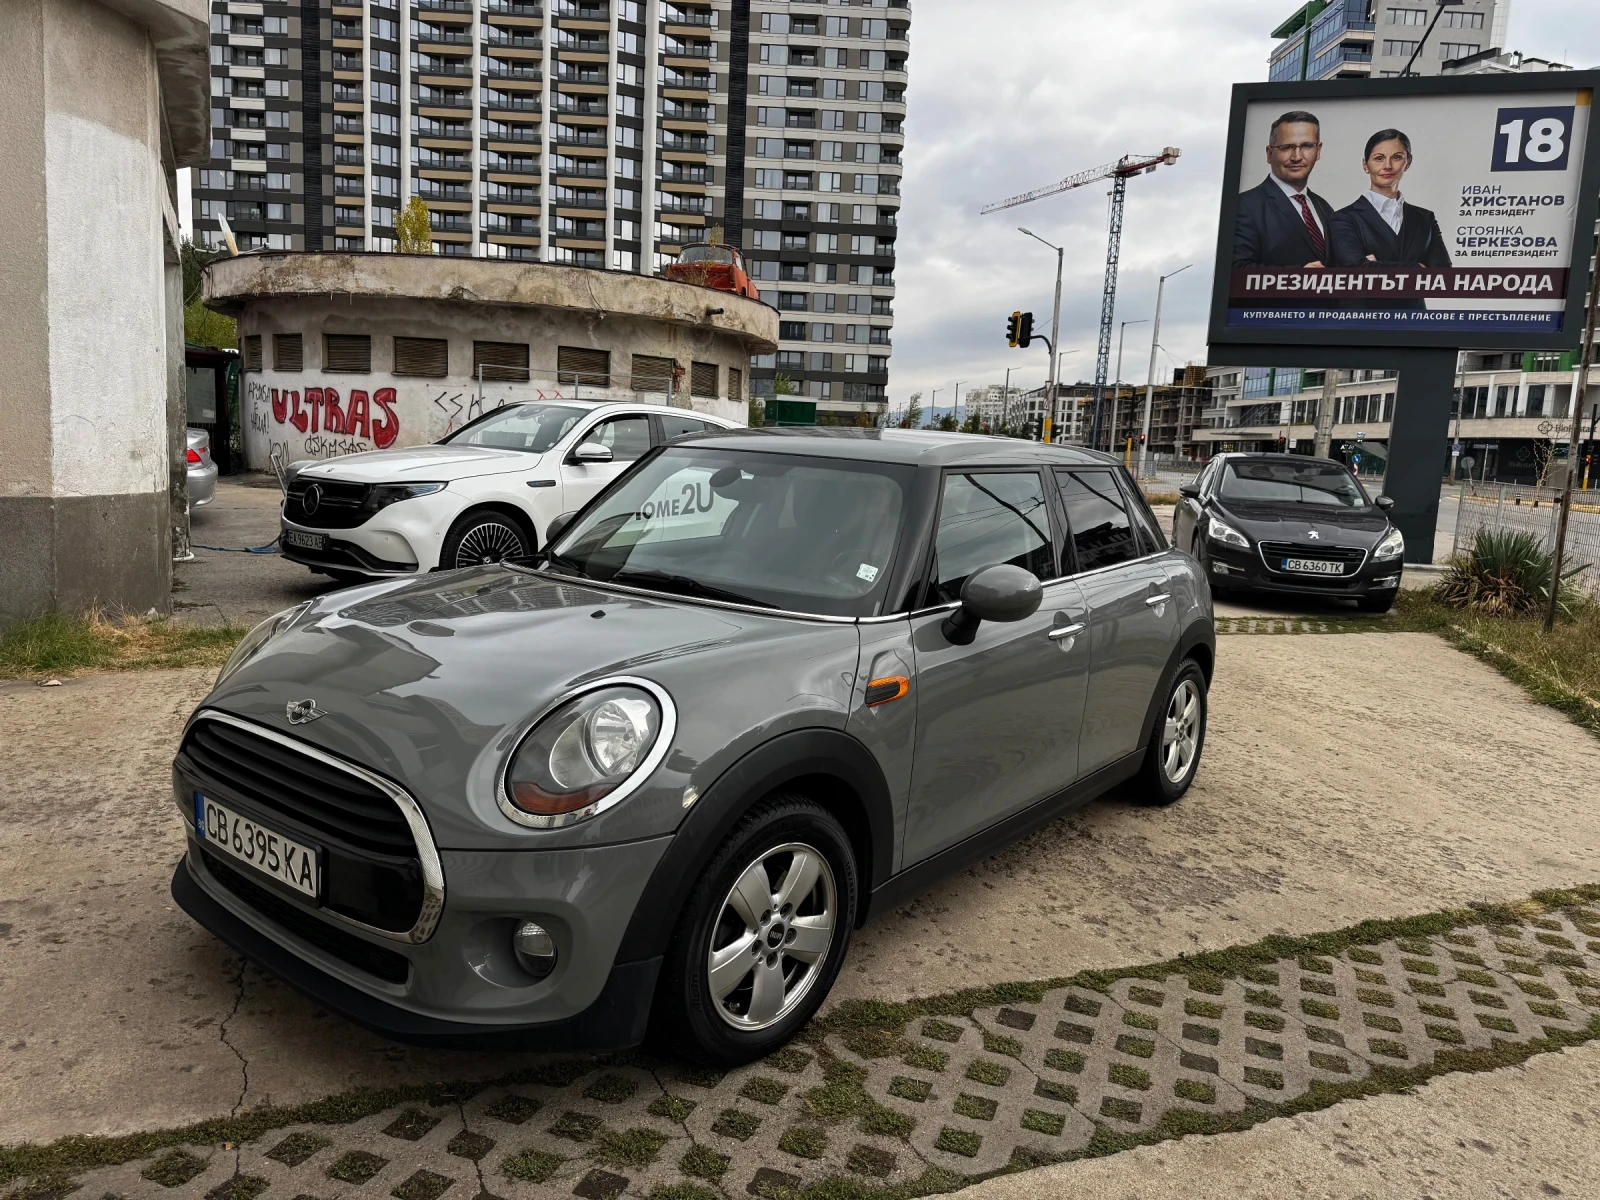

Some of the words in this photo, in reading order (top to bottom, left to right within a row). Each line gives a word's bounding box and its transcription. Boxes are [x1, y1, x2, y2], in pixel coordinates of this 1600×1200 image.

[1499, 118, 1565, 163] 18
[1462, 185, 1502, 195] ИВАН
[1460, 195, 1565, 207] ХРИСТАНОВ
[1459, 209, 1472, 217] ЗА
[1475, 208, 1536, 217] ПРЕЗИДЕНТ
[1457, 226, 1524, 236] СТОЯНКА
[1456, 236, 1558, 248] ЧЕРКЕЗОВА
[1470, 249, 1559, 258] ВИЦЕПРЕЗИДЕНТ
[1245, 274, 1409, 294] ПРЕЗИДЕНТЪТ
[1414, 274, 1447, 291] НА
[1453, 274, 1554, 295] НАРОДА
[1243, 311, 1306, 319] КУПУВАНЕТО
[1308, 311, 1315, 319] И
[1318, 312, 1391, 320] ПРОДАВАНЕТО
[1394, 312, 1408, 320] НА
[1411, 312, 1455, 321] ГЛАСОВЕ
[1468, 312, 1551, 322] ПРЕСТЪПЛЕНИЕ
[271, 387, 400, 450] ULTRAS
[1288, 559, 1302, 570] CB
[1302, 560, 1328, 572] 6360
[1329, 562, 1342, 573] TK
[207, 803, 228, 846] CB
[232, 817, 280, 873] 6395
[284, 842, 314, 891] KA
